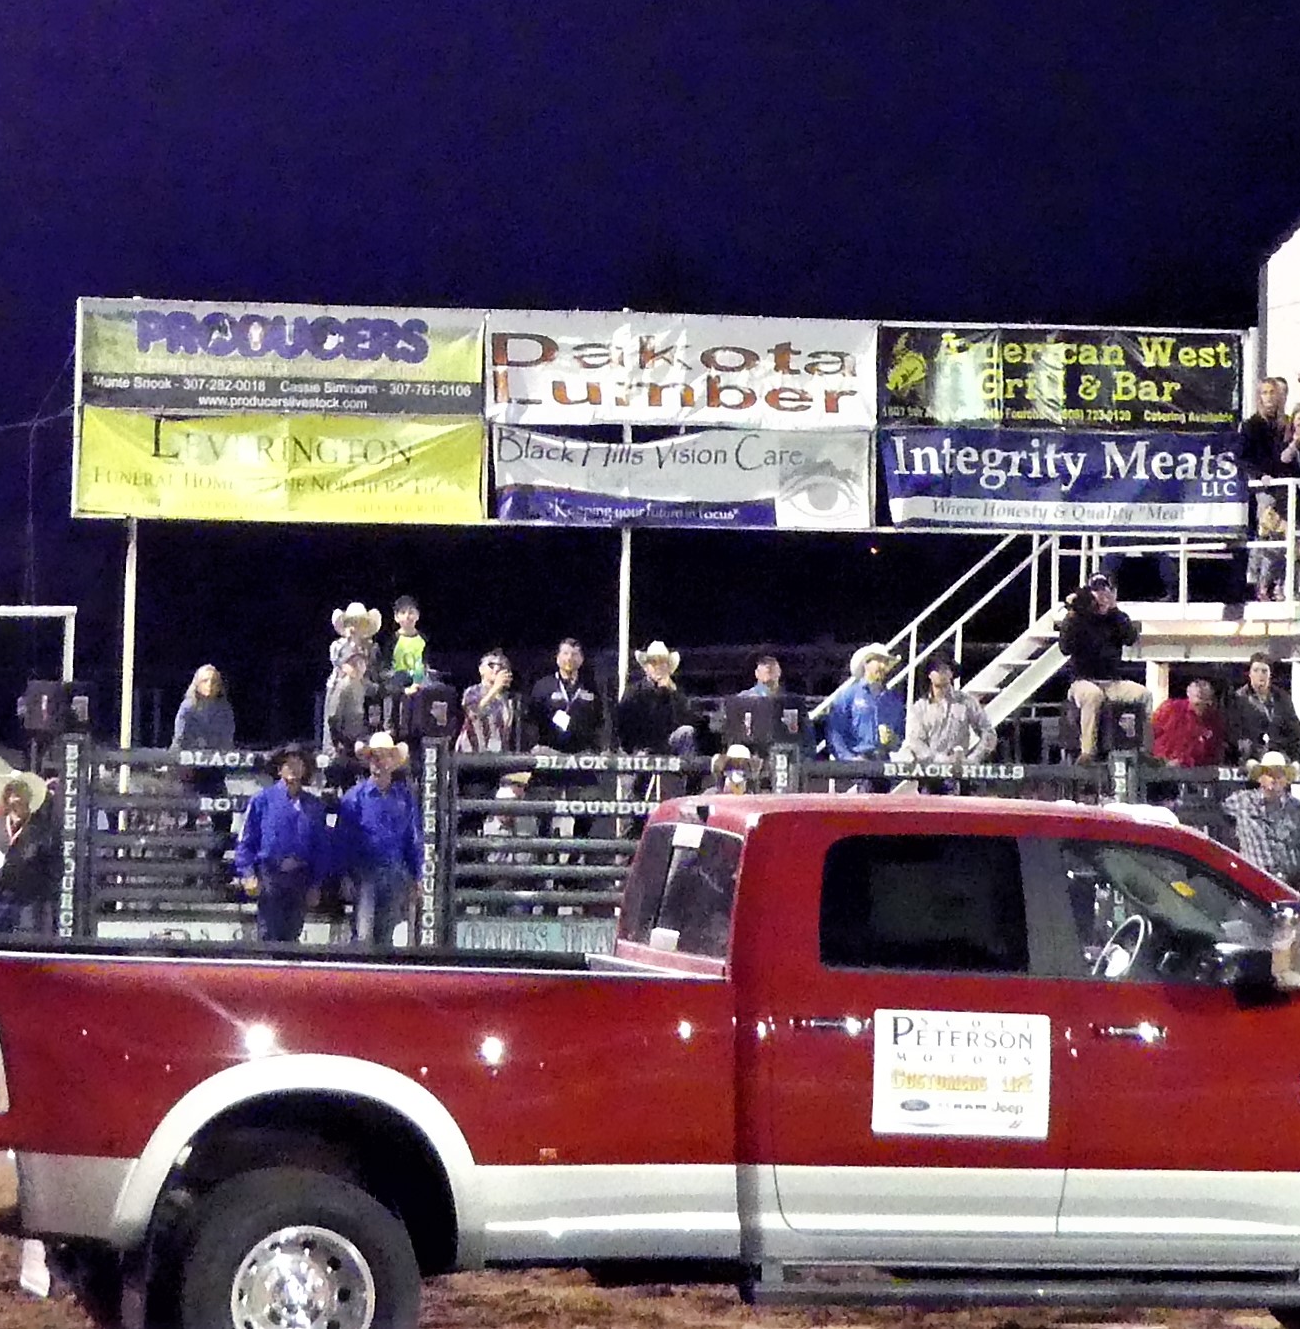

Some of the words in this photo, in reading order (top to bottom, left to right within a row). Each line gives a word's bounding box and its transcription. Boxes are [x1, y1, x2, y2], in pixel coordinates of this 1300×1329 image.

[136, 310, 430, 365] PRODUCERS
[490, 331, 857, 378] Dakota
[1137, 336, 1233, 369] West
[492, 370, 860, 414] Lumber
[980, 369, 1067, 402] Gril
[1078, 375, 1102, 401] &
[1111, 370, 1182, 403] Bar
[497, 427, 582, 466] Black
[655, 443, 728, 470] Vision
[734, 433, 804, 471] Care
[891, 435, 1087, 492] Integrity
[1101, 440, 1239, 482] Meats
[1201, 480, 1238, 497] LLC
[535, 755, 609, 770] BLACK
[616, 756, 681, 772] HILLS
[883, 762, 954, 778] BLACK
[962, 764, 1025, 780] HILLS
[59, 840, 76, 938] FOURCH
[421, 843, 436, 945] FOURCH
[891, 1015, 1033, 1050] PETERSON
